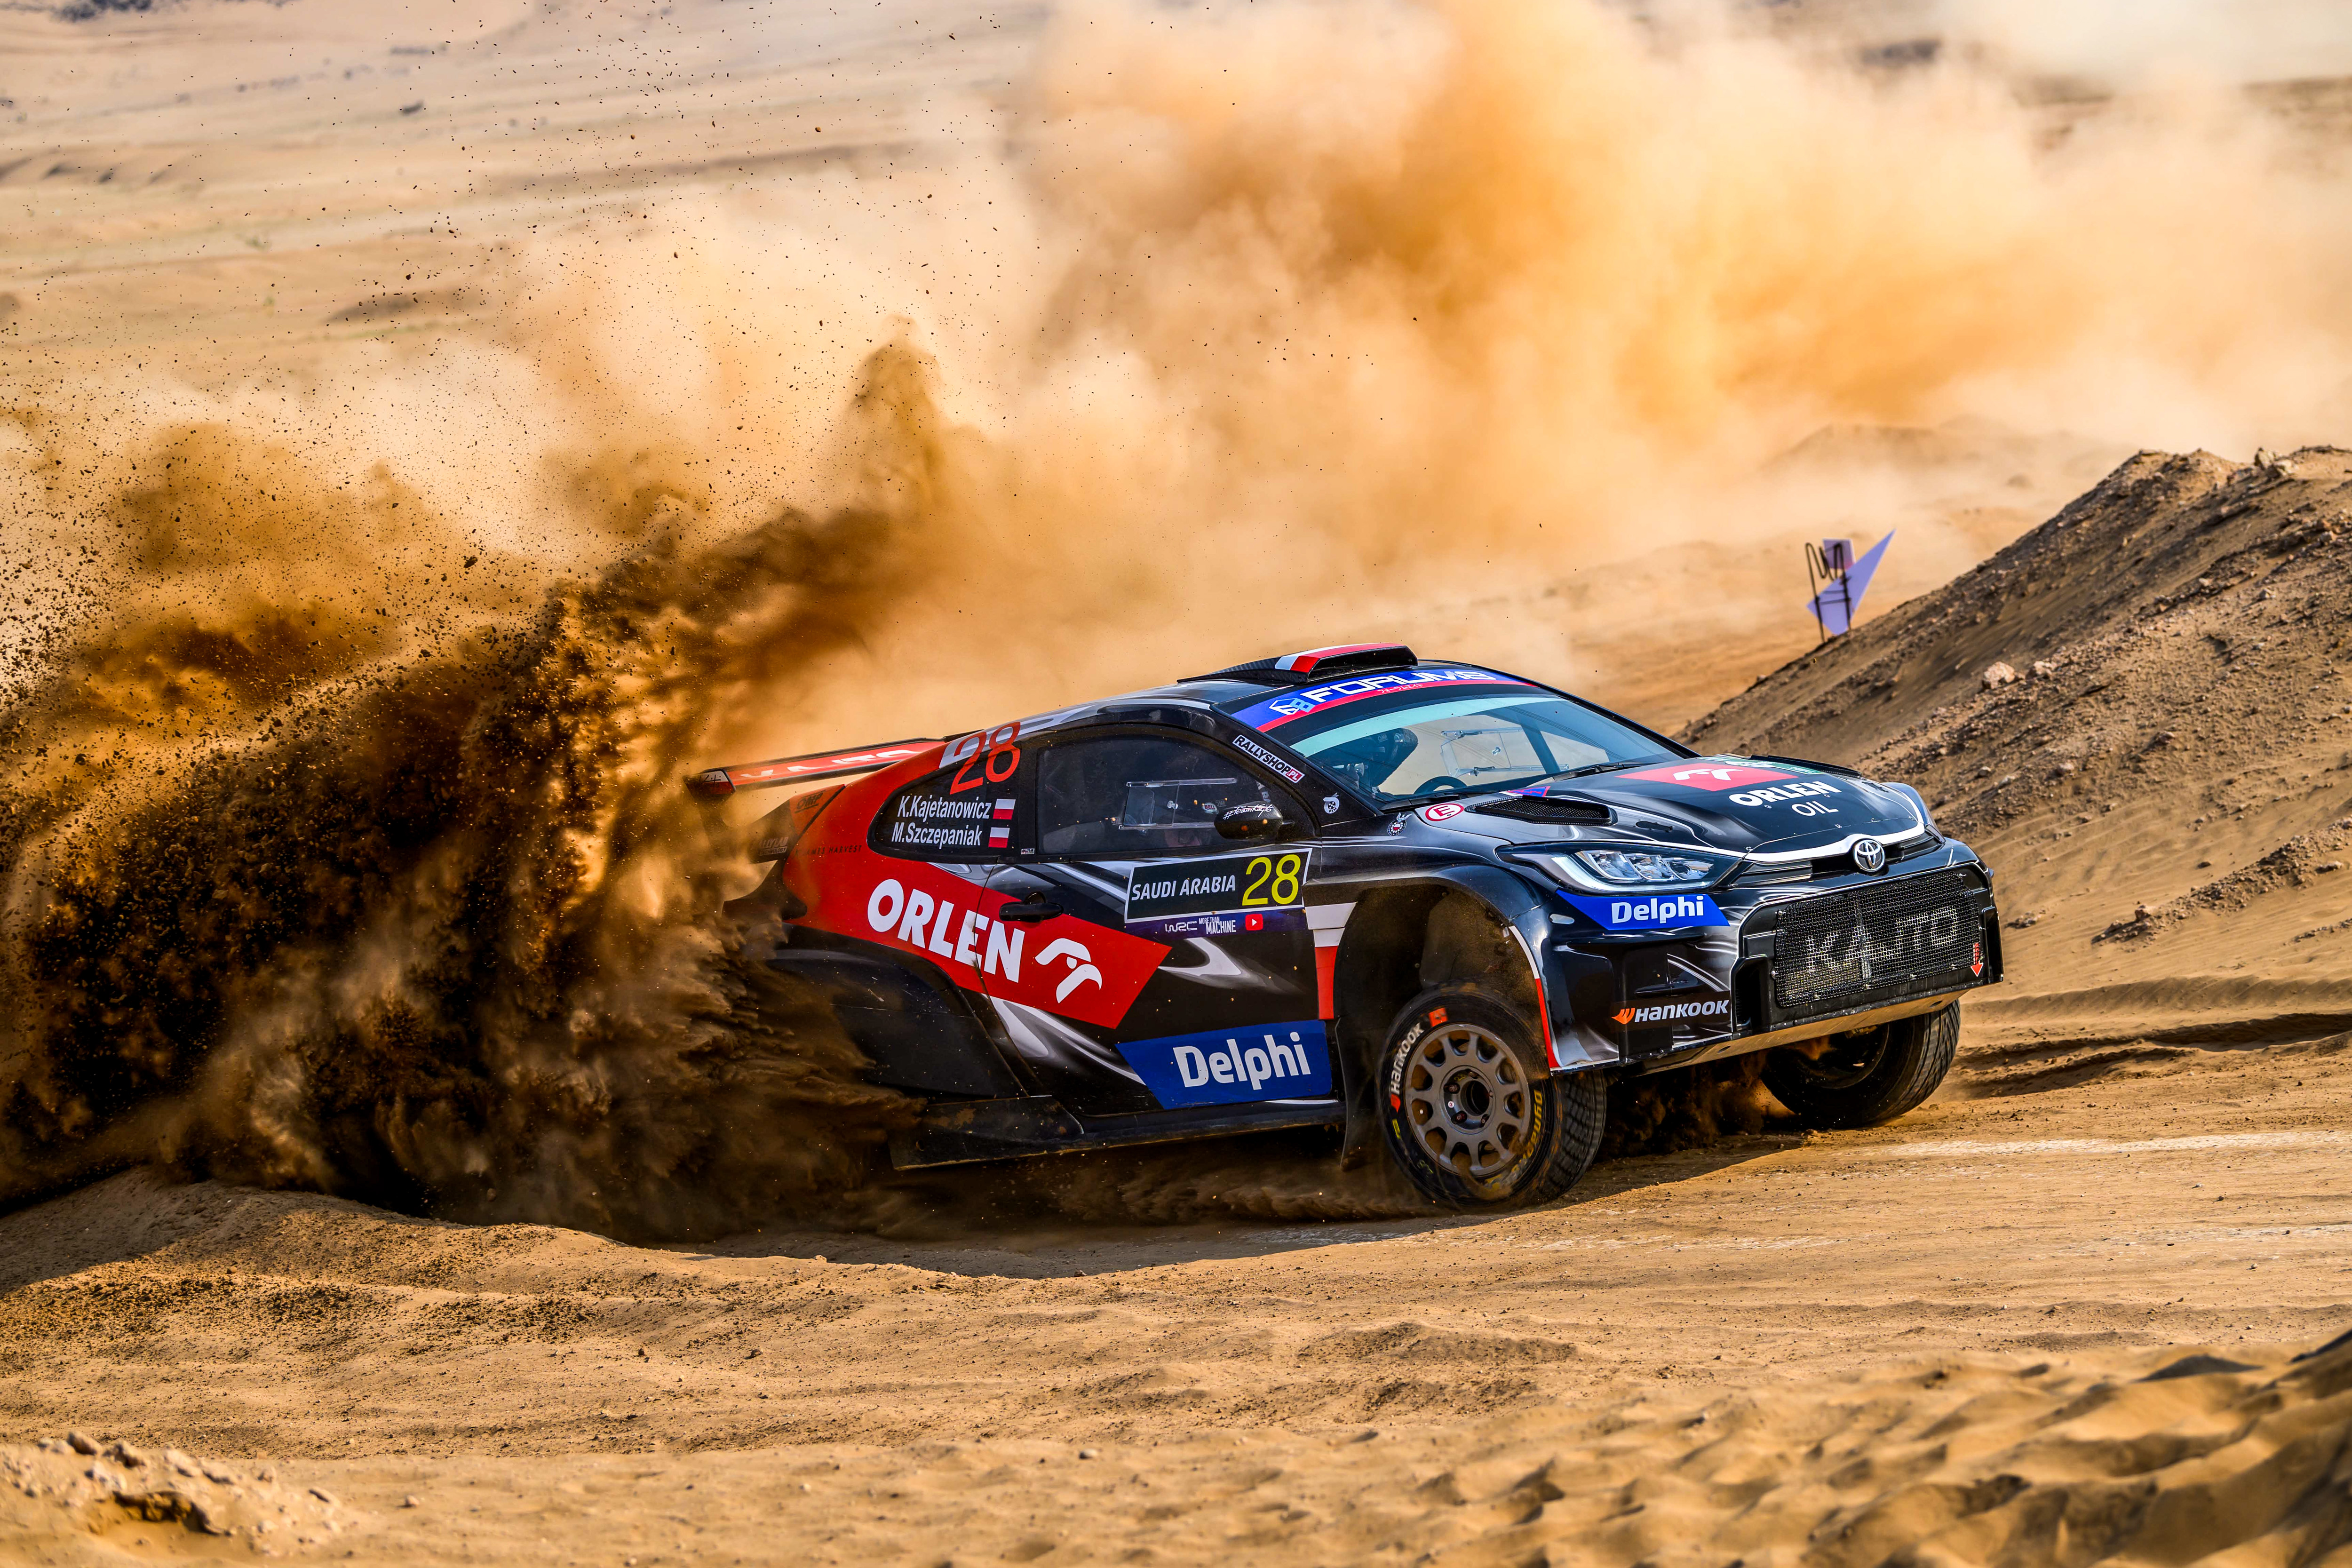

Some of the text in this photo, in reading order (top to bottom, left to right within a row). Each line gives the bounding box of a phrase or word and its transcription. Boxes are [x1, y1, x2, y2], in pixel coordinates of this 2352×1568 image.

[1300, 671, 1497, 702] FORUM8
[950, 722, 1021, 795] 28
[1234, 736, 1300, 781] RALLYSHOP.PL
[1729, 781, 1843, 806] ORLEN
[897, 795, 992, 822] K.Kajetanowicz
[1433, 805, 1455, 817] E
[1791, 801, 1839, 817] OIL
[805, 845, 863, 855] AMES HARVEST
[891, 822, 983, 850] M.Szczepaniak
[1131, 875, 1236, 901] SAUDI ARABIA
[1242, 854, 1301, 906] 28
[1611, 895, 1704, 924] Delphi
[867, 879, 1025, 983] ORLEN
[1206, 920, 1237, 935] MACHINE
[1173, 1032, 1311, 1090] Delphi
